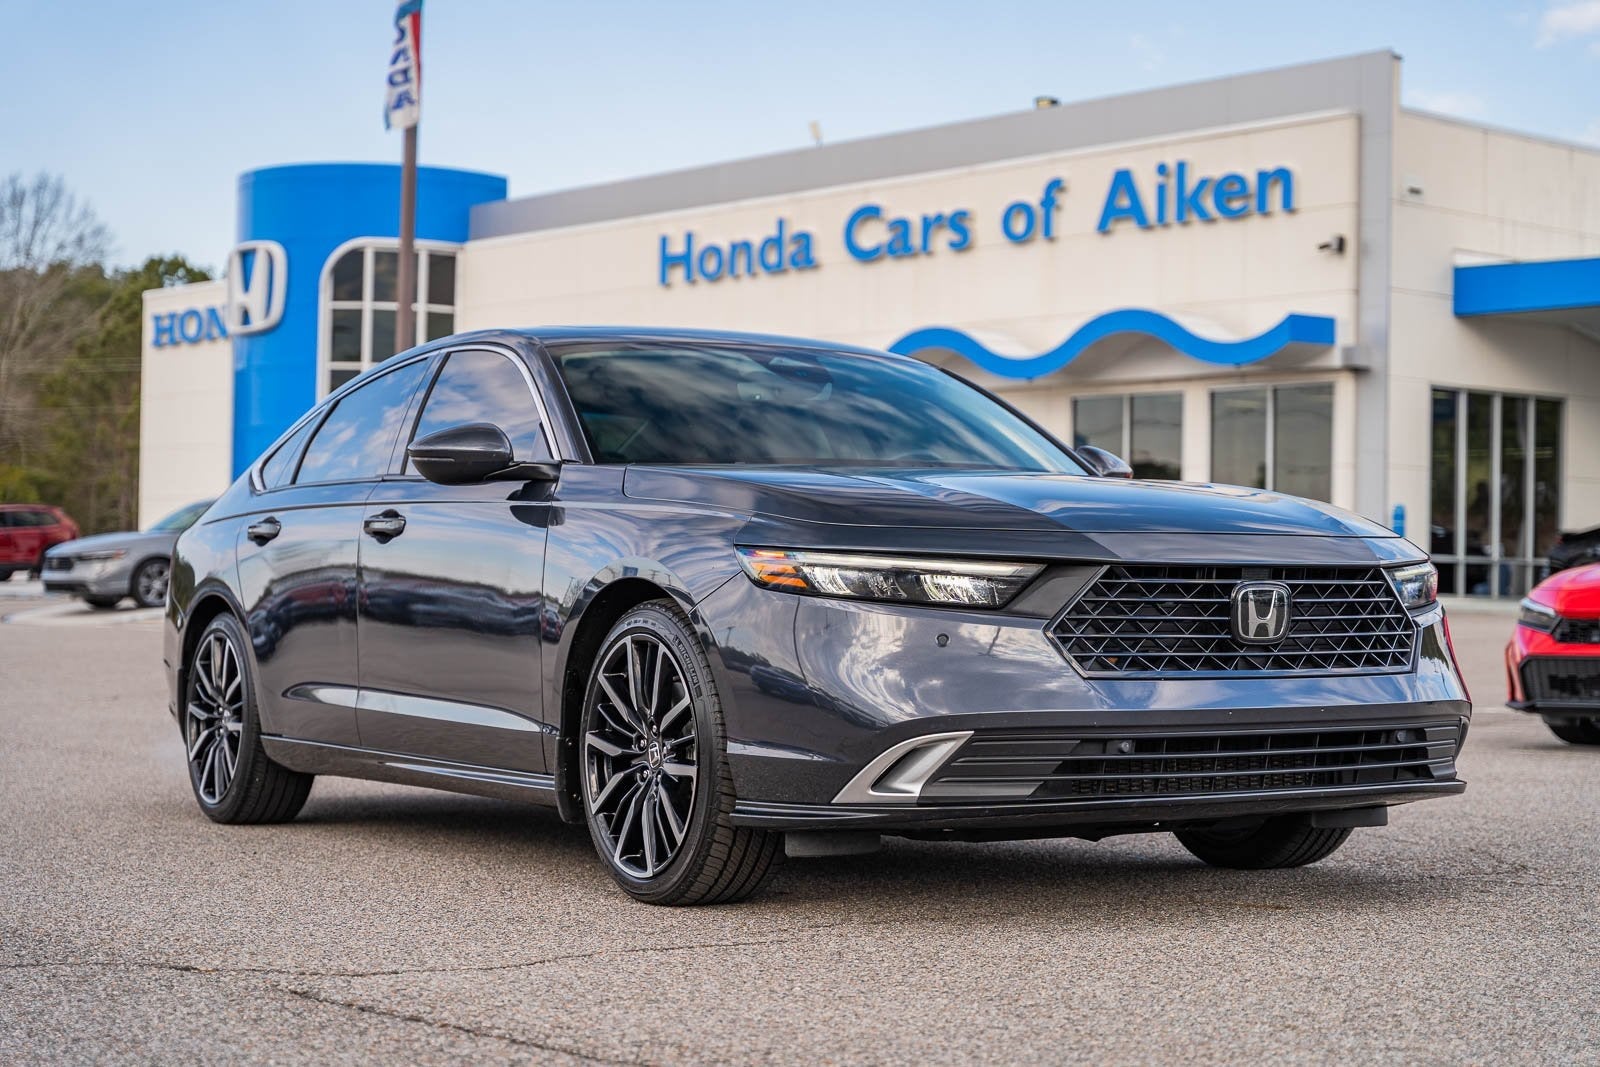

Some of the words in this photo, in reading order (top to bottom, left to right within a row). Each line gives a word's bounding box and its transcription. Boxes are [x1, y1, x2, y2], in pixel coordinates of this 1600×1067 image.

[659, 217, 816, 286] Honda
[844, 204, 971, 263] Cars
[1002, 177, 1064, 243] of
[1096, 160, 1294, 233] Aiken
[677, 641, 700, 686] MICHELIN
